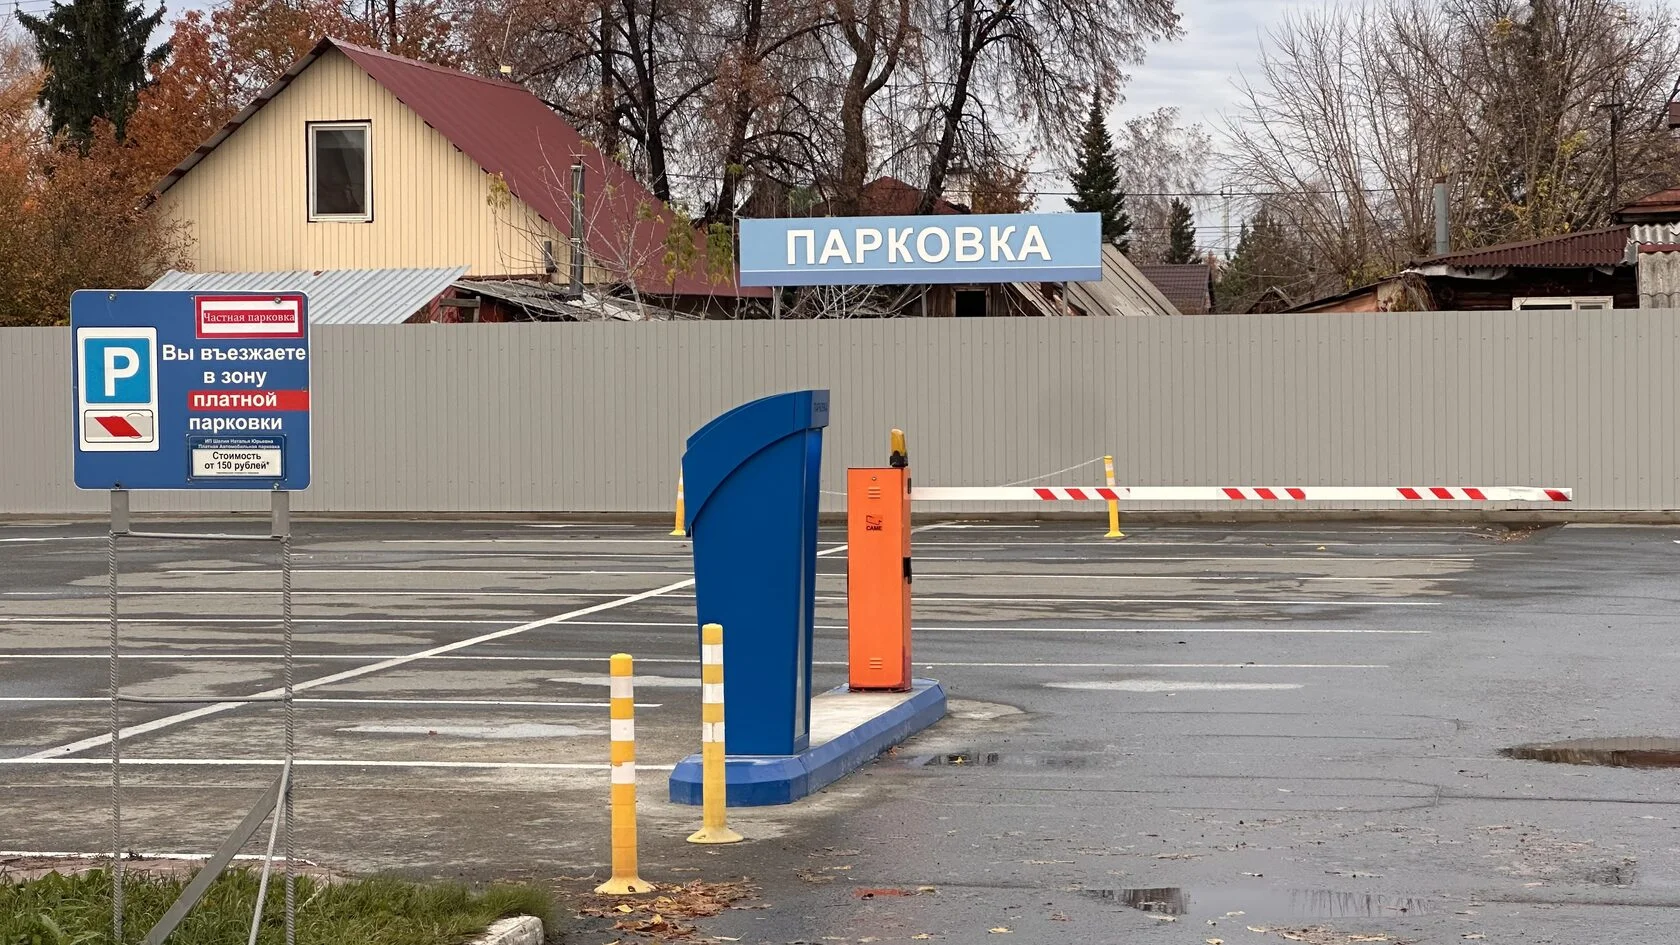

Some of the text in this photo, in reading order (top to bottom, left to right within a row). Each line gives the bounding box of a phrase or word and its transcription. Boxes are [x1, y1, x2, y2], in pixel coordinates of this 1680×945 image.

[786, 225, 1052, 265] ПАРКОВКА
[204, 312, 295, 324] Частная парковка
[162, 344, 306, 361] Вы въезжаете
[104, 347, 140, 397] P
[203, 371, 267, 388] в зону
[193, 391, 277, 407] платной
[189, 417, 282, 434] парковки
[212, 451, 262, 460] Стоимость
[217, 461, 232, 469] 150
